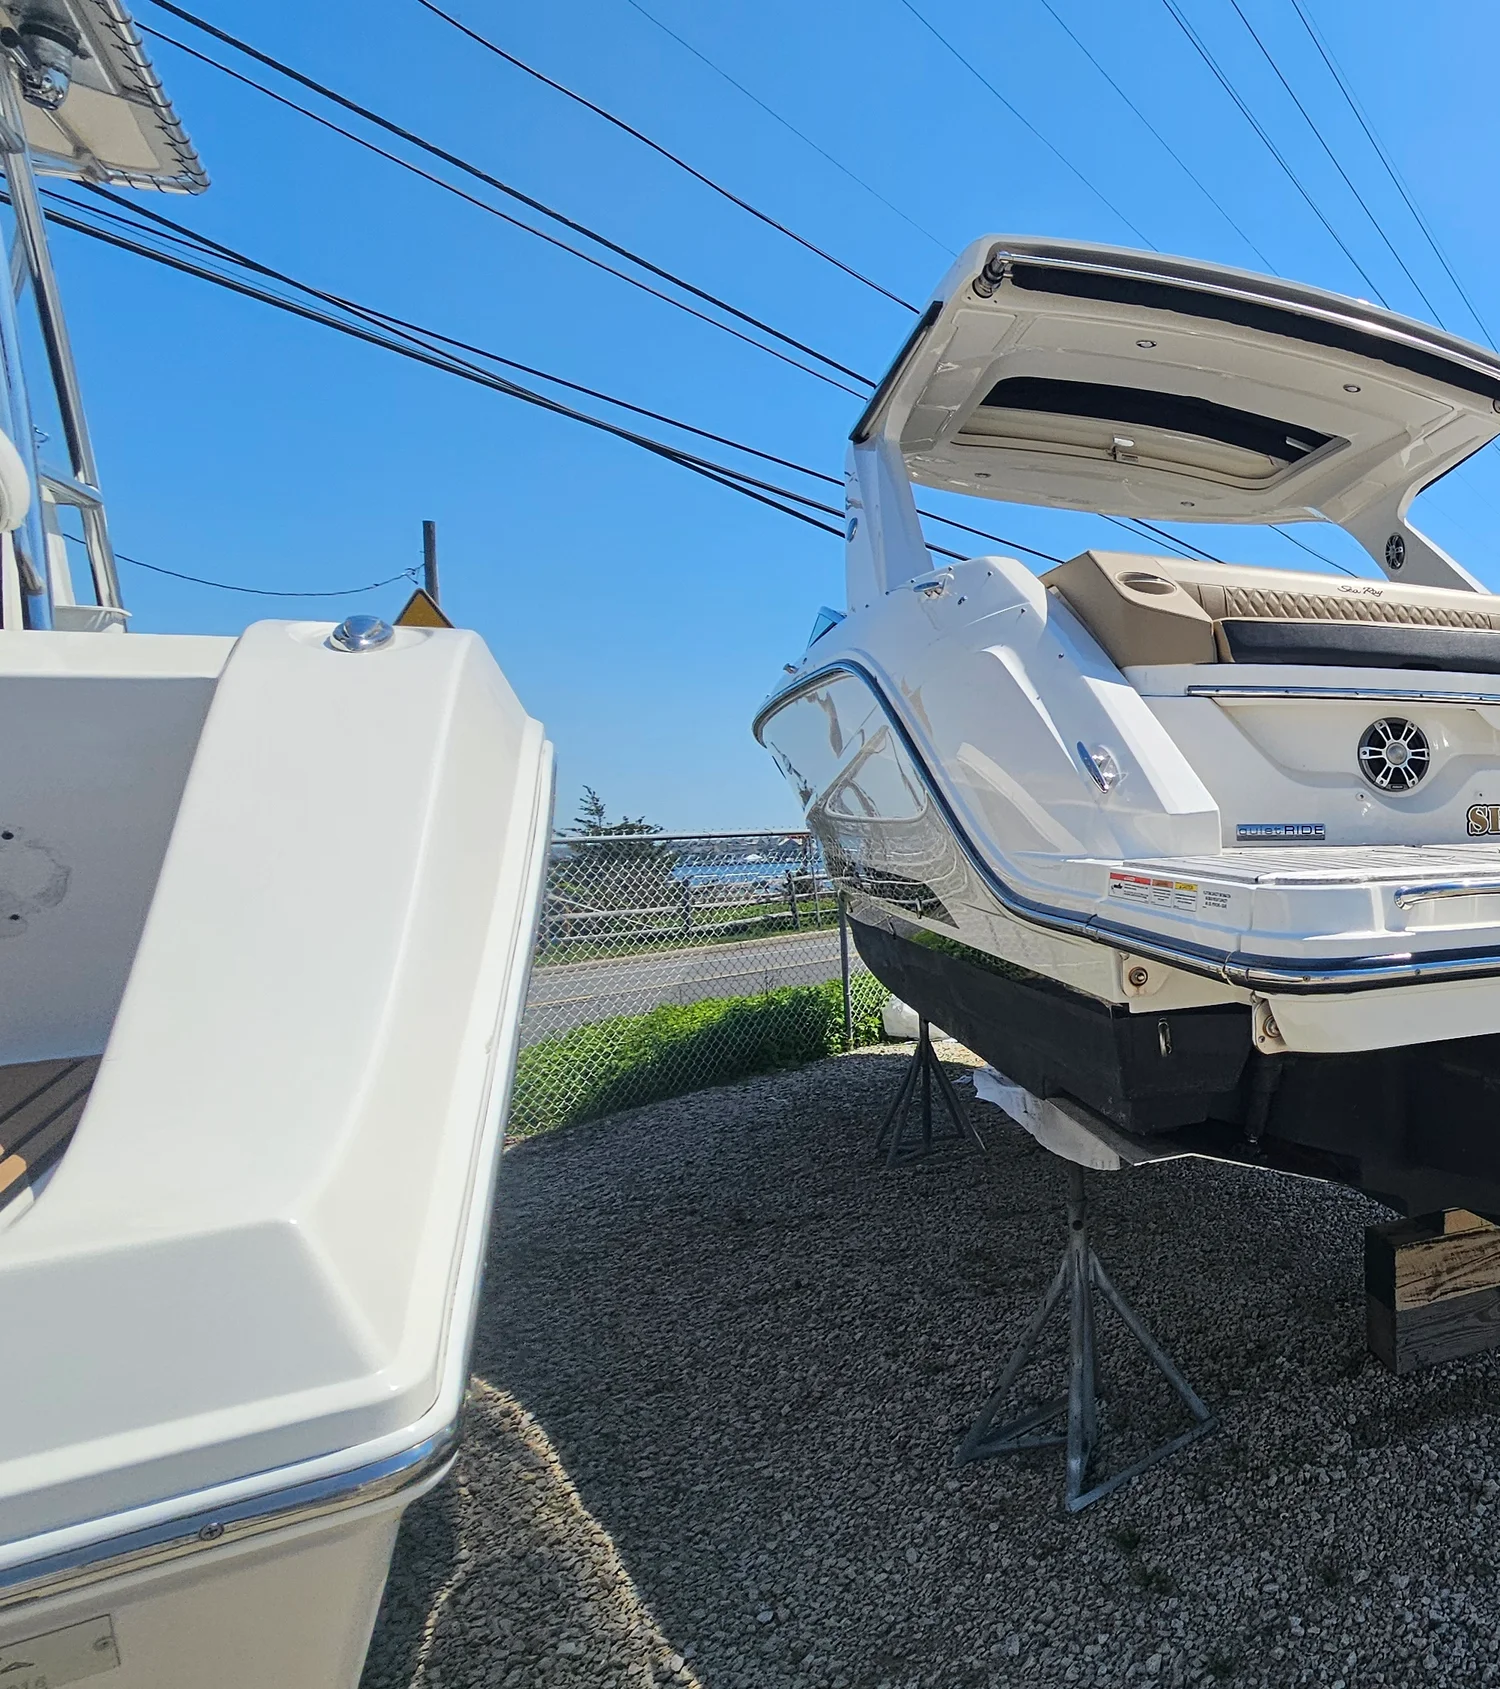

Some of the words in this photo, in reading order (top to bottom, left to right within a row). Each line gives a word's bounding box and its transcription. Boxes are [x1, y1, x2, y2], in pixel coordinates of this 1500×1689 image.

[1337, 585, 1361, 593] Sea
[1363, 587, 1383, 597] Ray
[1238, 825, 1324, 836] quietRIDE
